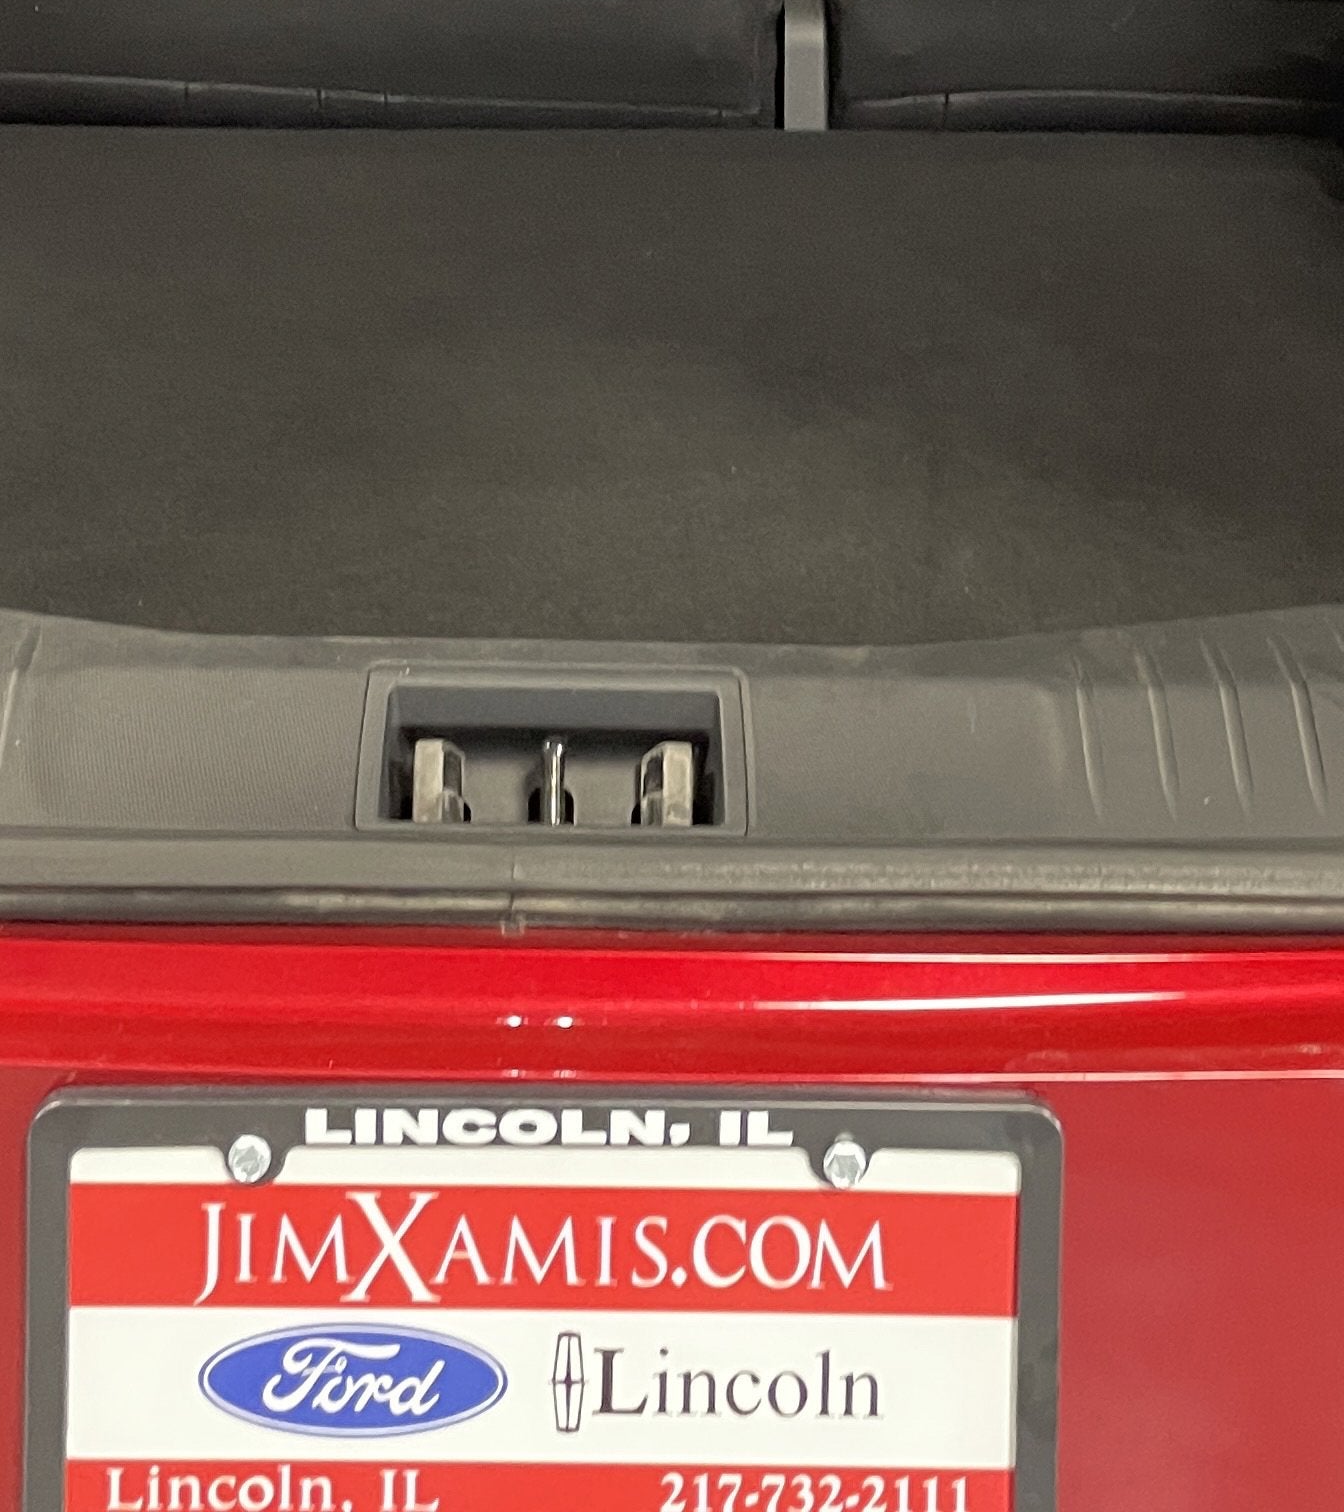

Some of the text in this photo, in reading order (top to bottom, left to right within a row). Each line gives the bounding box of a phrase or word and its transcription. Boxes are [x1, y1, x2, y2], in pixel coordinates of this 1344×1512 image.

[305, 1107, 794, 1146] LINCOLN, IL
[262, 1338, 444, 1416] Ford
[593, 1347, 882, 1418] Lincoln
[380, 1468, 440, 1512] IL
[660, 1472, 968, 1512] 217-732-2111
